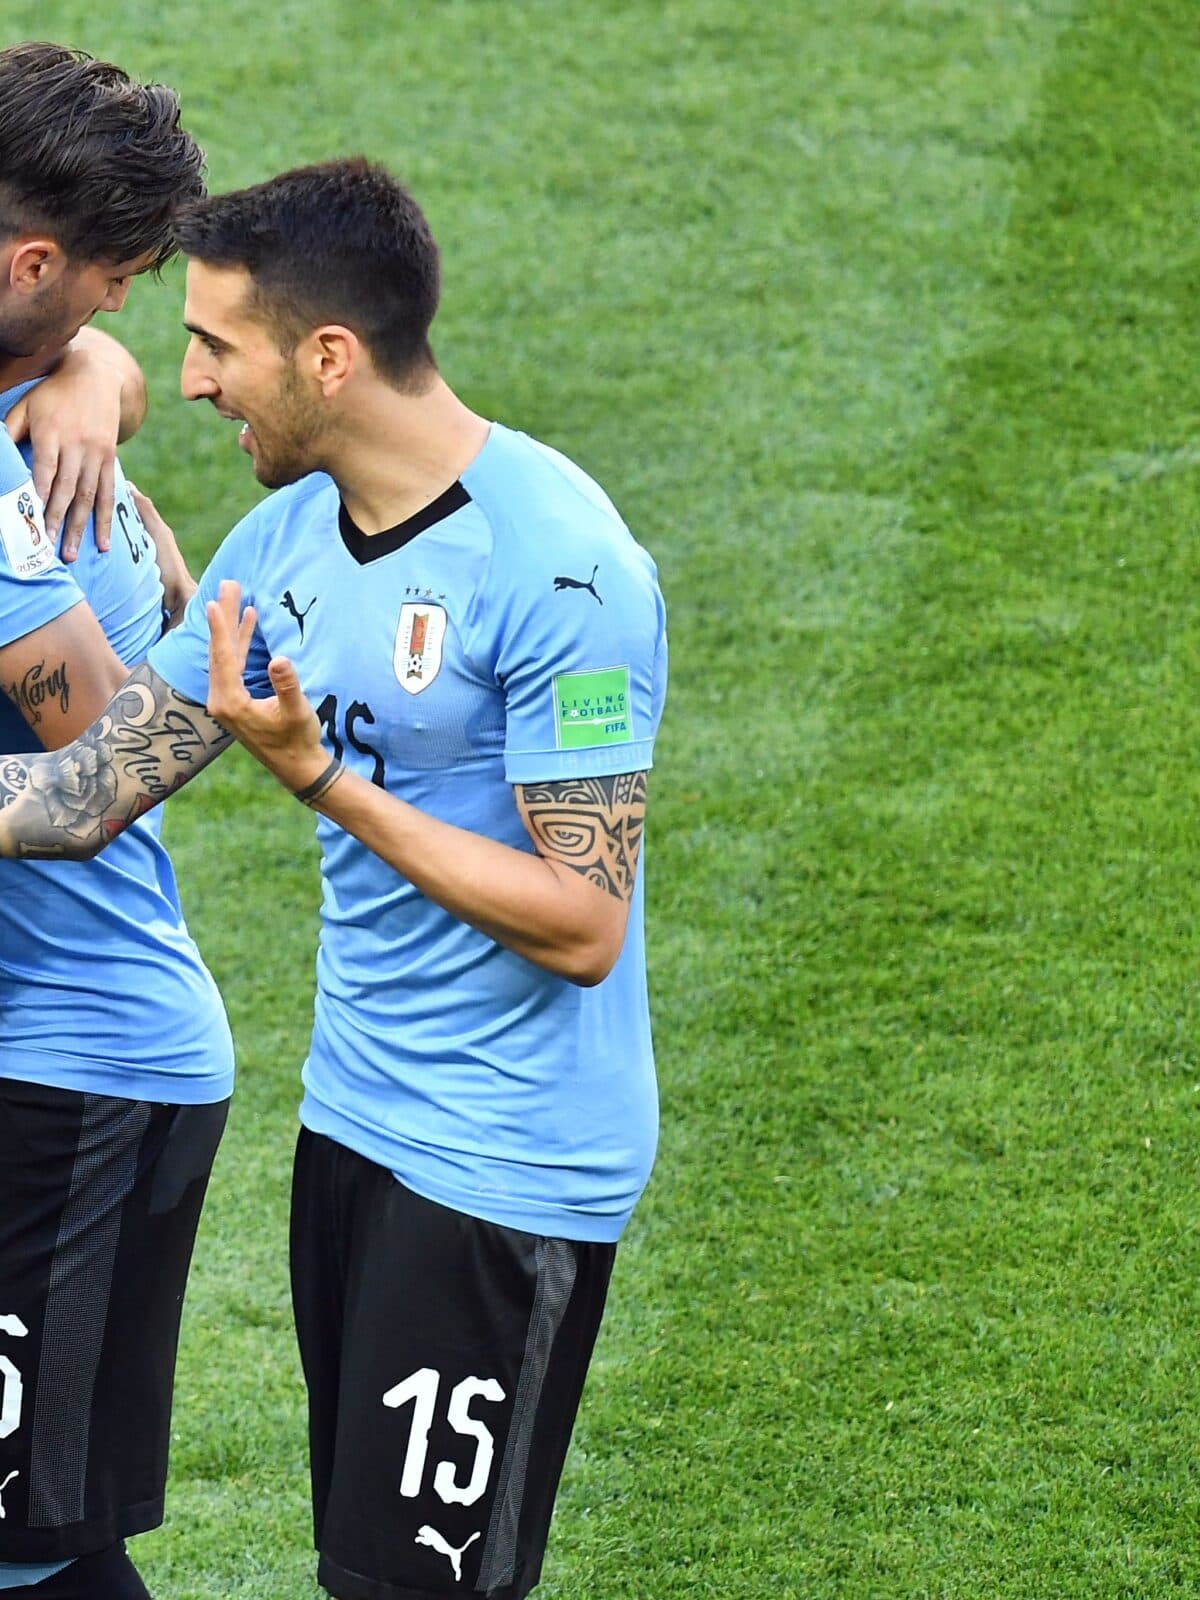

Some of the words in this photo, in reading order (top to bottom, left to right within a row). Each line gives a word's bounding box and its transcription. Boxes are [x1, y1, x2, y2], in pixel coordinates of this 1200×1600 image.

[561, 693, 624, 708] LIVING
[562, 703, 624, 717] FOOTBALL
[605, 722, 626, 733] FIFA
[382, 1367, 506, 1507] 15
